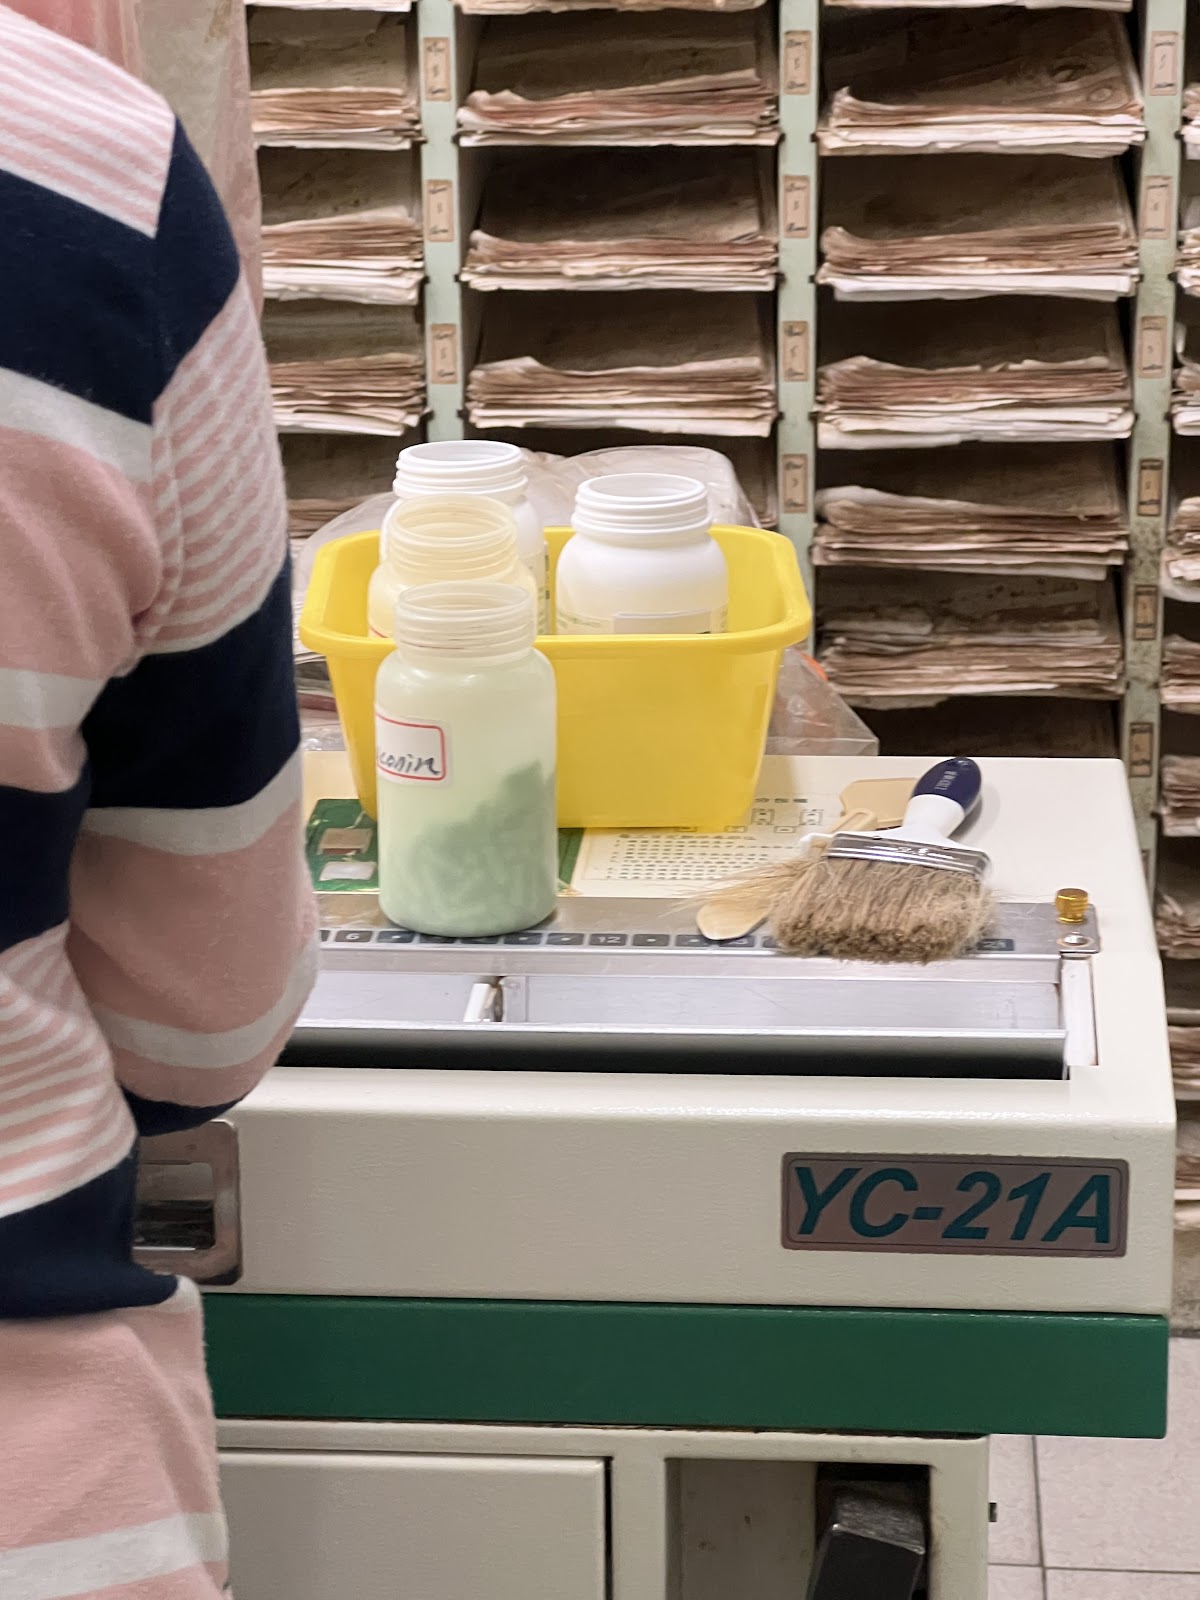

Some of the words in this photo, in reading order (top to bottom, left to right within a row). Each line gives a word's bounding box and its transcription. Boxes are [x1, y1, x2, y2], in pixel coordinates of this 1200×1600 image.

[345, 932, 360, 940] 6
[597, 935, 621, 944] 12
[794, 1166, 1111, 1244] YC-21A
